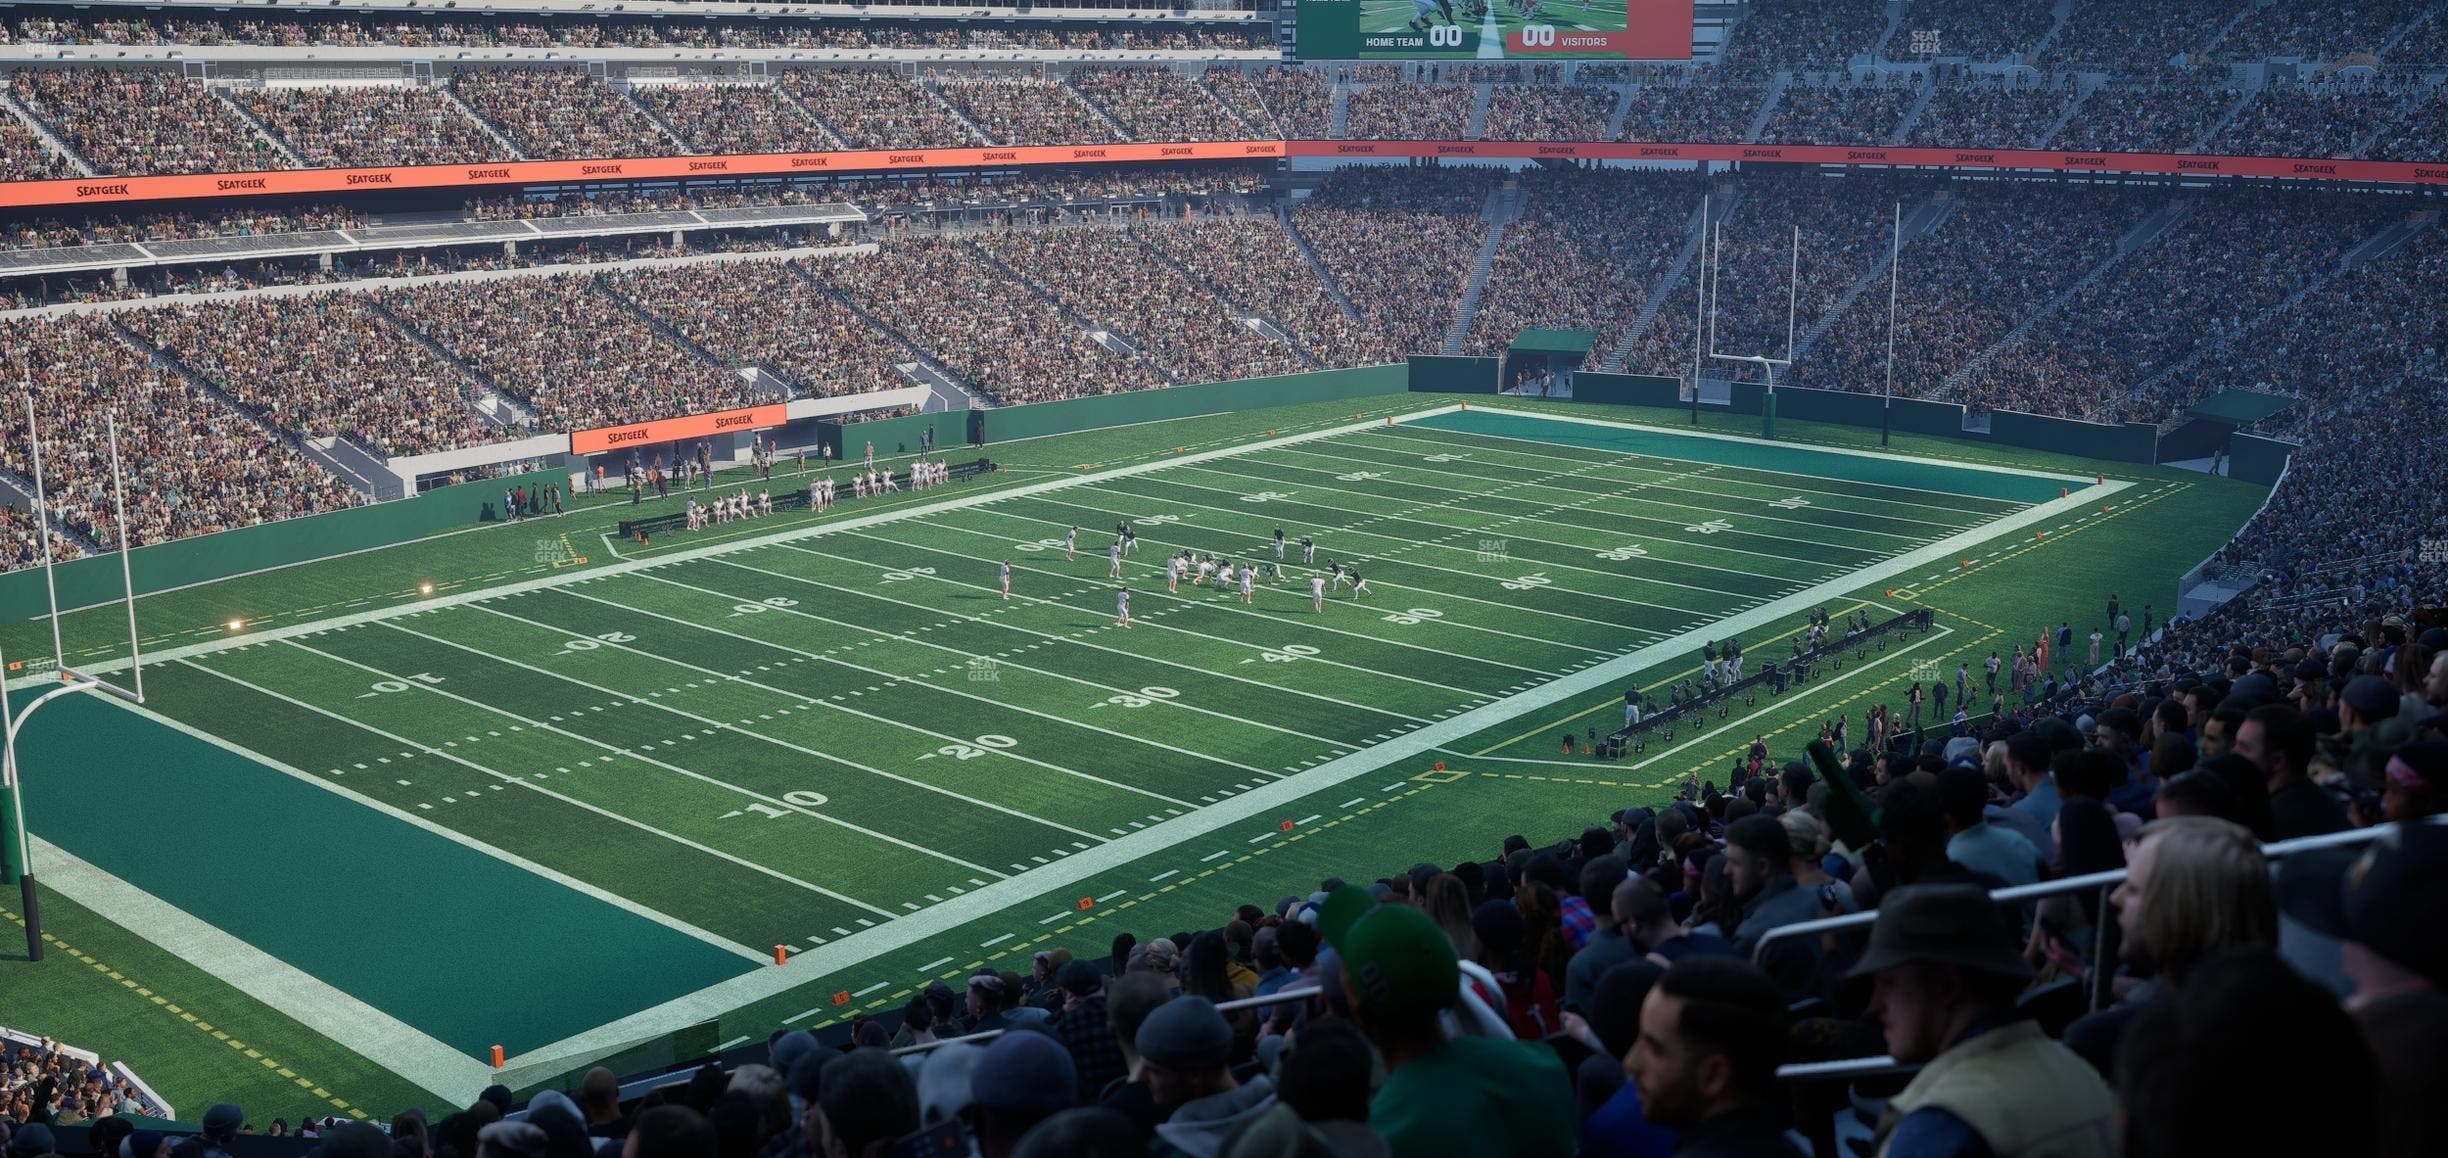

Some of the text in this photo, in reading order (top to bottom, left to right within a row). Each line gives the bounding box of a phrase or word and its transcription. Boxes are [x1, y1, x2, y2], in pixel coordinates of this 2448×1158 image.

[1429, 24, 1463, 47] 00
[1522, 24, 1556, 47] 00
[1366, 37, 1424, 47] HOME TEAM
[1561, 37, 1608, 47] VISITORS
[1074, 149, 1106, 158] SEATGEEK
[1161, 147, 1193, 156] SEATGEEK
[1246, 145, 1276, 153] SEATGEEK
[1337, 144, 1375, 153] SEATGEEK
[1438, 145, 1474, 154] SEATGEEK
[1538, 146, 1576, 155] SEATGEEK
[1640, 148, 1678, 157] SEATGEEK
[1743, 149, 1782, 159] SEATGEEK
[889, 155, 924, 164] SEATGEEK
[982, 151, 1017, 161] SEATGEEK
[1847, 151, 1887, 161] SEATGEEK
[1955, 153, 1995, 164] SEATGEEK
[2064, 156, 2106, 166] SEATGEEK
[689, 161, 729, 172] SEATGEEK
[791, 158, 828, 168] SEATGEEK
[2177, 159, 2220, 171] SEATGEEK
[468, 169, 511, 180] SEATGEEK
[582, 165, 622, 176] SEATGEEK
[2293, 164, 2337, 175] SEATGEEK
[217, 178, 266, 191] SEATGEEK
[346, 173, 392, 185] SEATGEEK
[76, 183, 130, 197] SEATGEEK
[715, 414, 754, 429] SEATGEEK
[607, 428, 650, 444] SEATGEEK
[1596, 547, 1648, 561] 30
[1501, 575, 1552, 590] 40
[733, 597, 799, 614] 30
[1381, 608, 1443, 625] 50
[564, 630, 637, 651] 20
[1259, 644, 1321, 665] 40
[371, 671, 446, 694] 10
[1107, 686, 1180, 709] 30
[938, 734, 1018, 760] 20
[740, 790, 828, 819] 10
